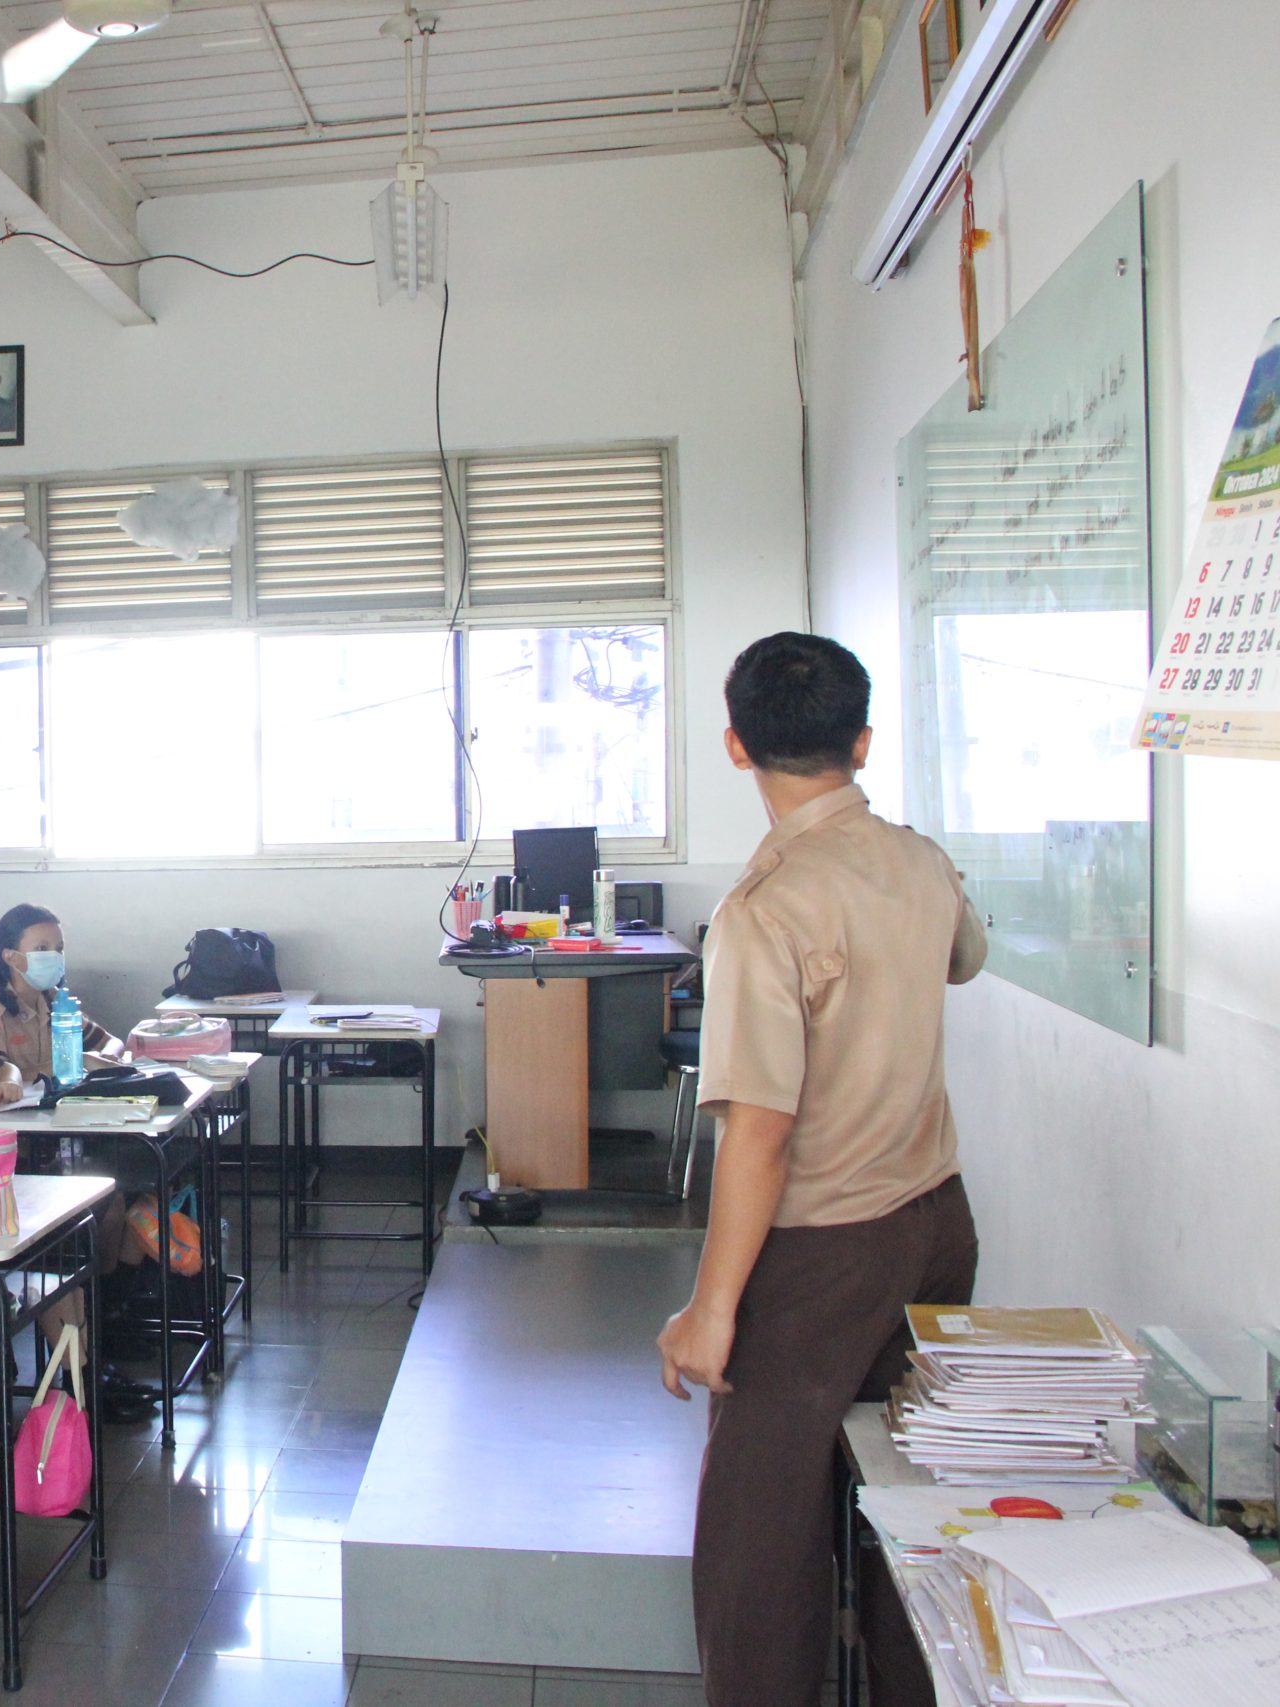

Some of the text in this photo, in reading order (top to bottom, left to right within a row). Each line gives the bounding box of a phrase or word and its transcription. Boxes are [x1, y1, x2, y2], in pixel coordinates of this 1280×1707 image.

[1254, 519, 1263, 542] 1
[1198, 553, 1274, 583] 6 7 8 9
[1184, 597, 1201, 619] 13
[1206, 596, 1224, 618] 14
[1228, 594, 1245, 617] 15
[1250, 591, 1266, 615] 16
[1169, 627, 1276, 654] 20 21 22 23 24
[1159, 668, 1180, 689] 27
[1181, 668, 1202, 690] 28
[1203, 668, 1223, 691] 29
[1225, 668, 1245, 691] 30
[1247, 667, 1263, 691] 31
